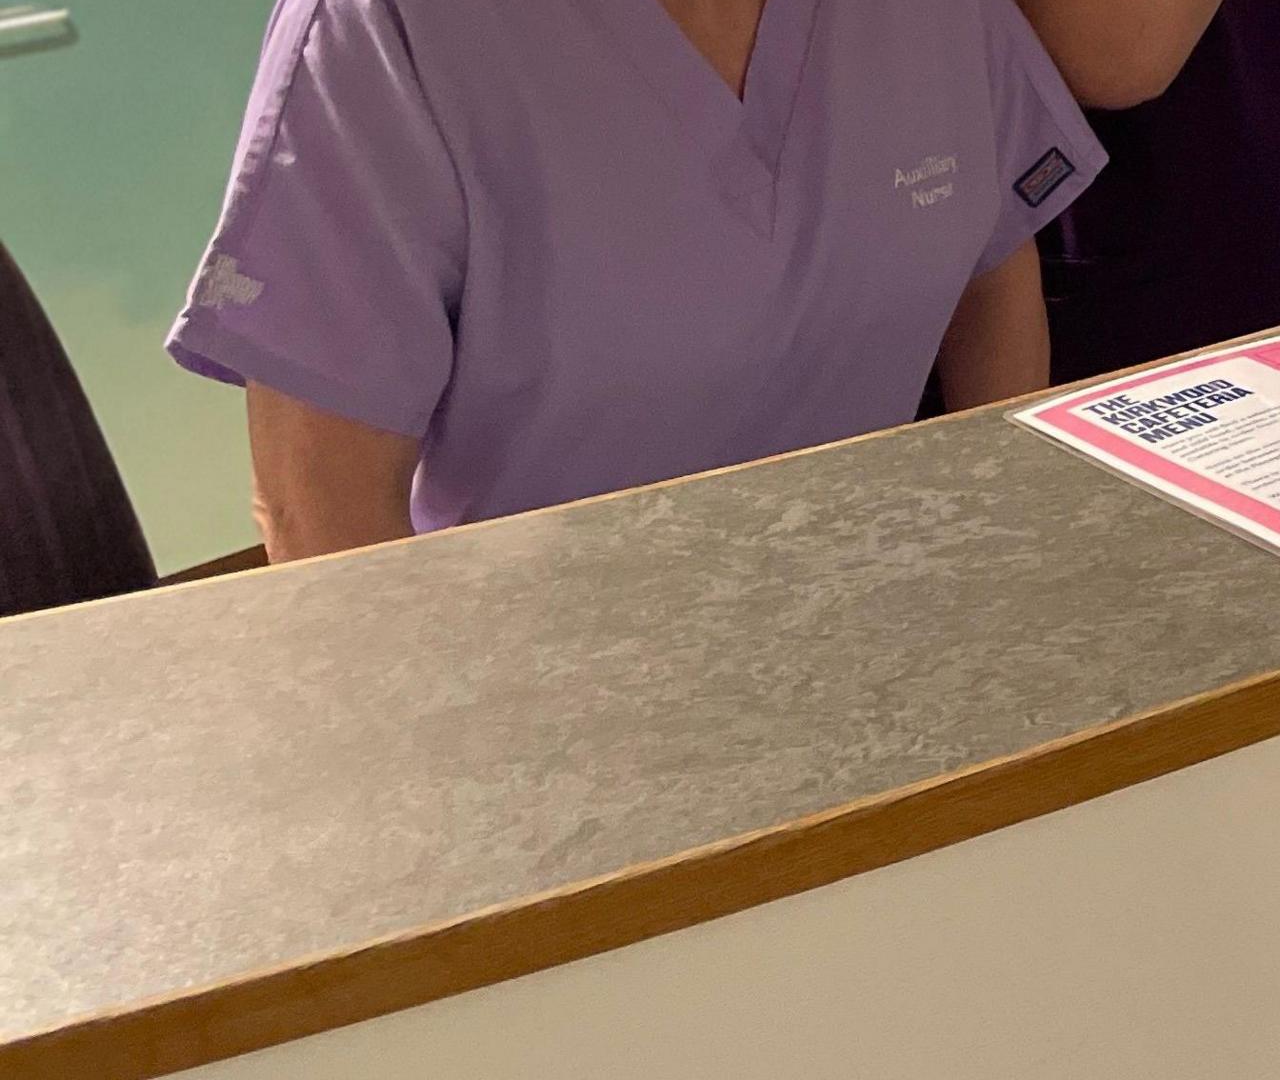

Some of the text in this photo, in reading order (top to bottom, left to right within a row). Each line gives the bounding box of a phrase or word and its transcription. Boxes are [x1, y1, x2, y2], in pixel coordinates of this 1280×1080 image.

[1082, 394, 1141, 415] THE
[1101, 379, 1235, 425] KIRKWOOD
[1120, 387, 1254, 434] CAFETERIA
[1137, 412, 1219, 444] MENU
